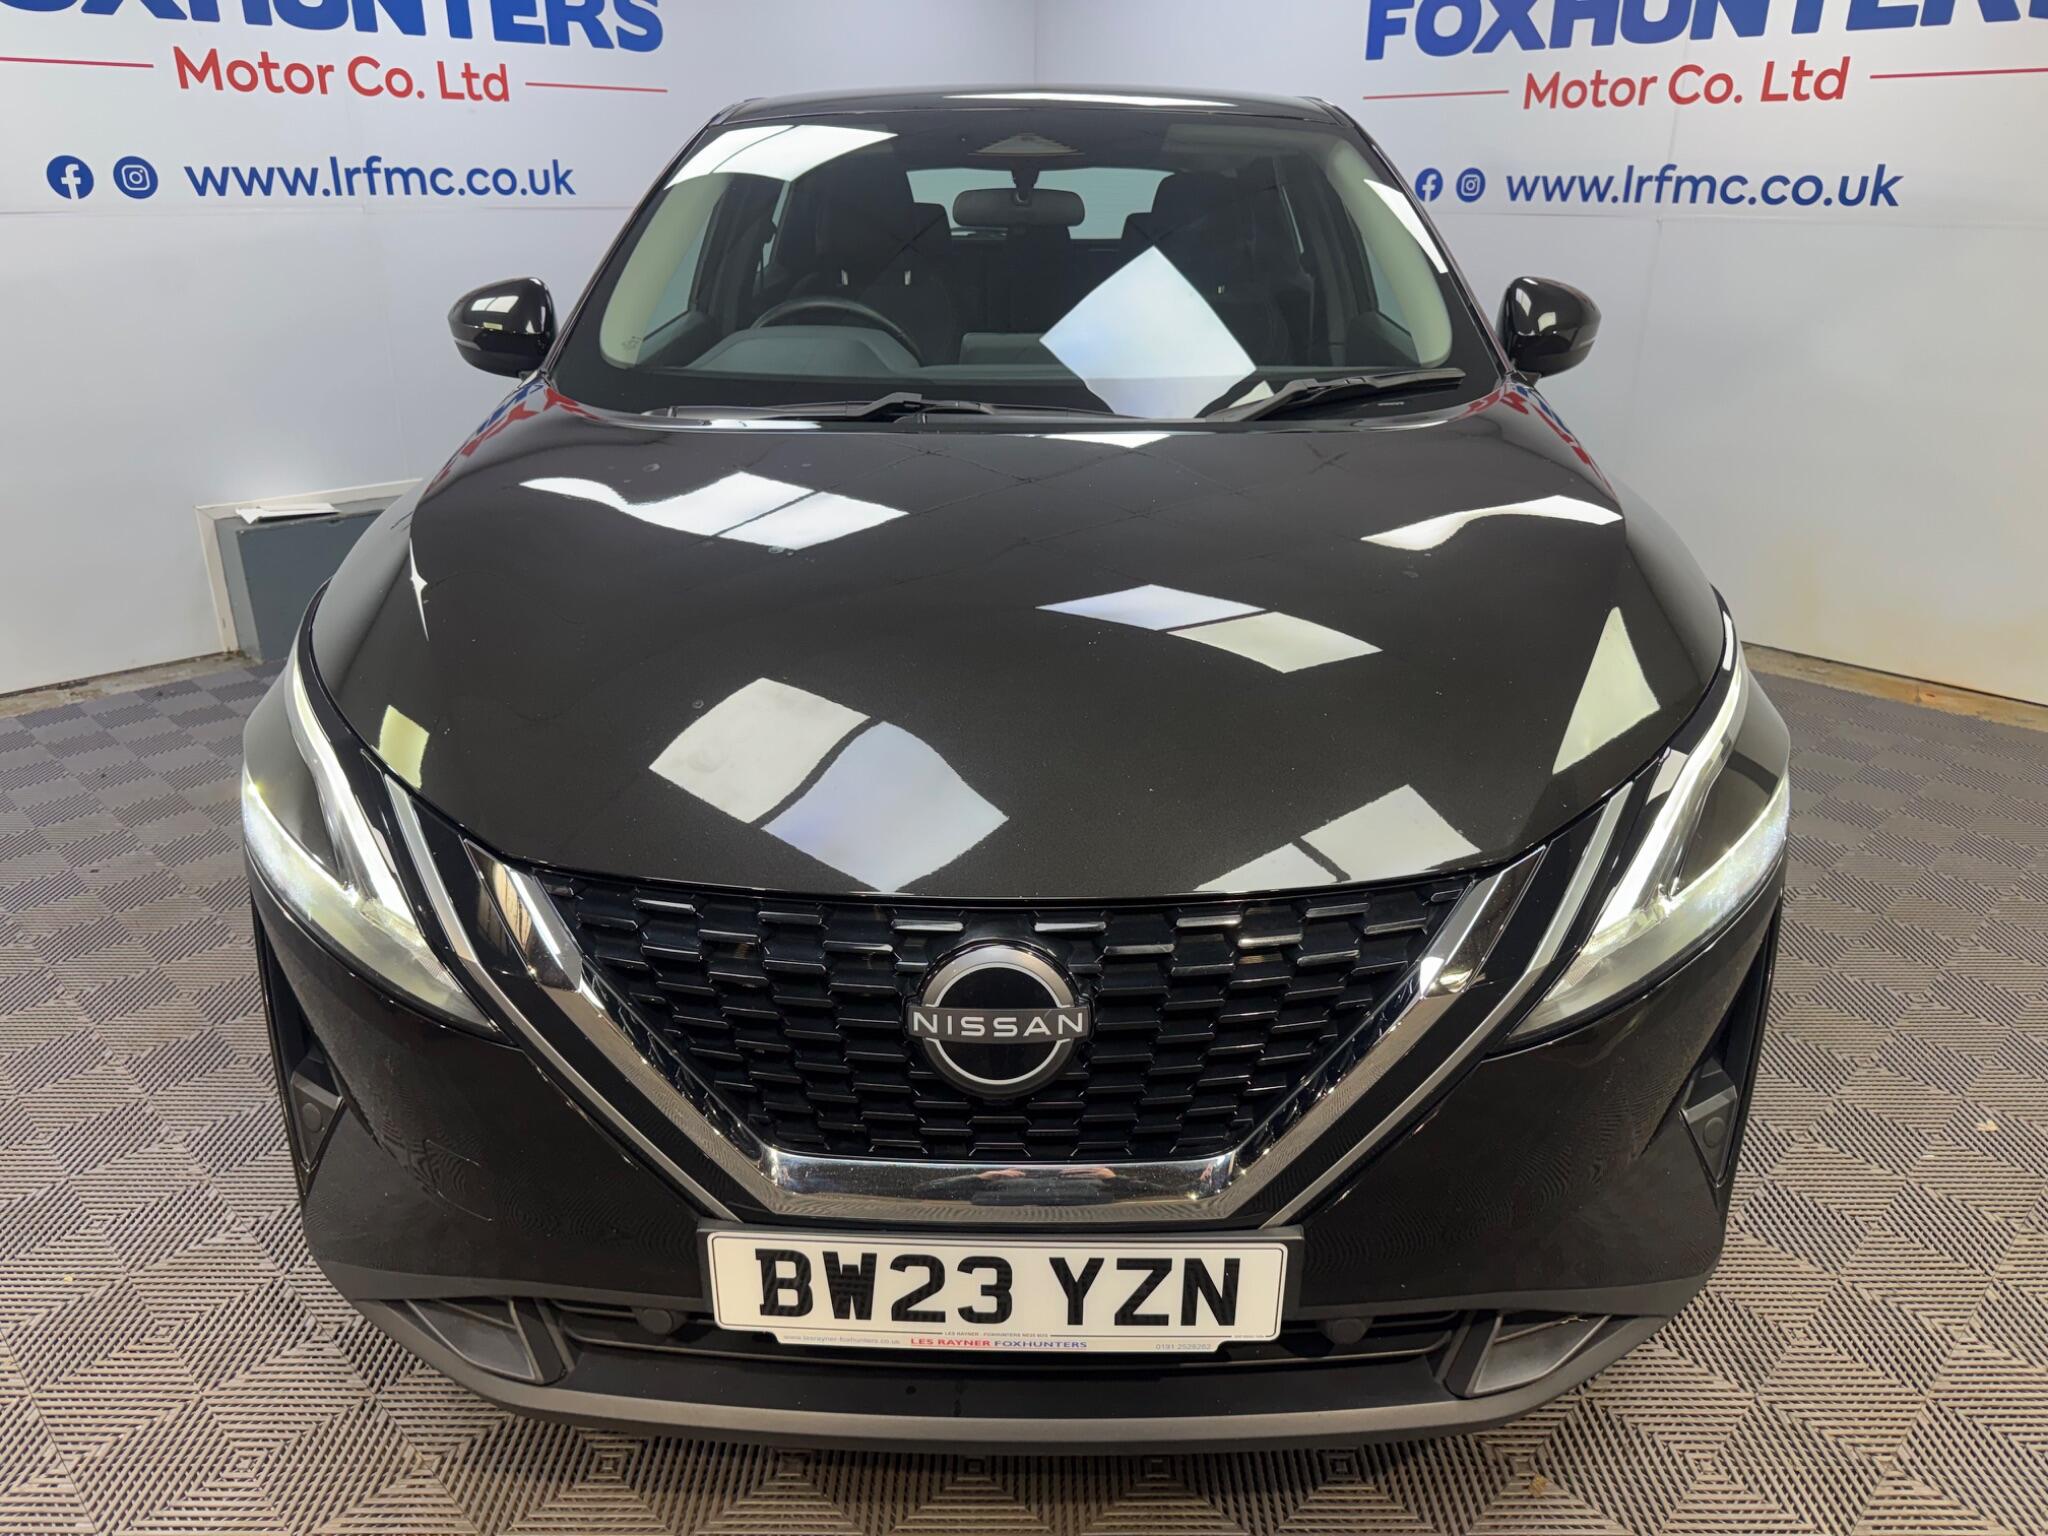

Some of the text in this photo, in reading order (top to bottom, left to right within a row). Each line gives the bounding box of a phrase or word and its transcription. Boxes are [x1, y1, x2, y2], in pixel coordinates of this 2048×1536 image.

[173, 47, 510, 102] Motor Co. Ltd
[1524, 56, 1851, 109] Motor Co. Ltd
[185, 155, 576, 197] www.lrfmc.co.uk
[1506, 163, 1904, 206] www.lrfmc.co.uk
[913, 1011, 1083, 1037] NISSAN
[754, 1248, 1241, 1327] BW23 YZN
[911, 1338, 1088, 1349] LES RAYNER FOXHUNTERS
